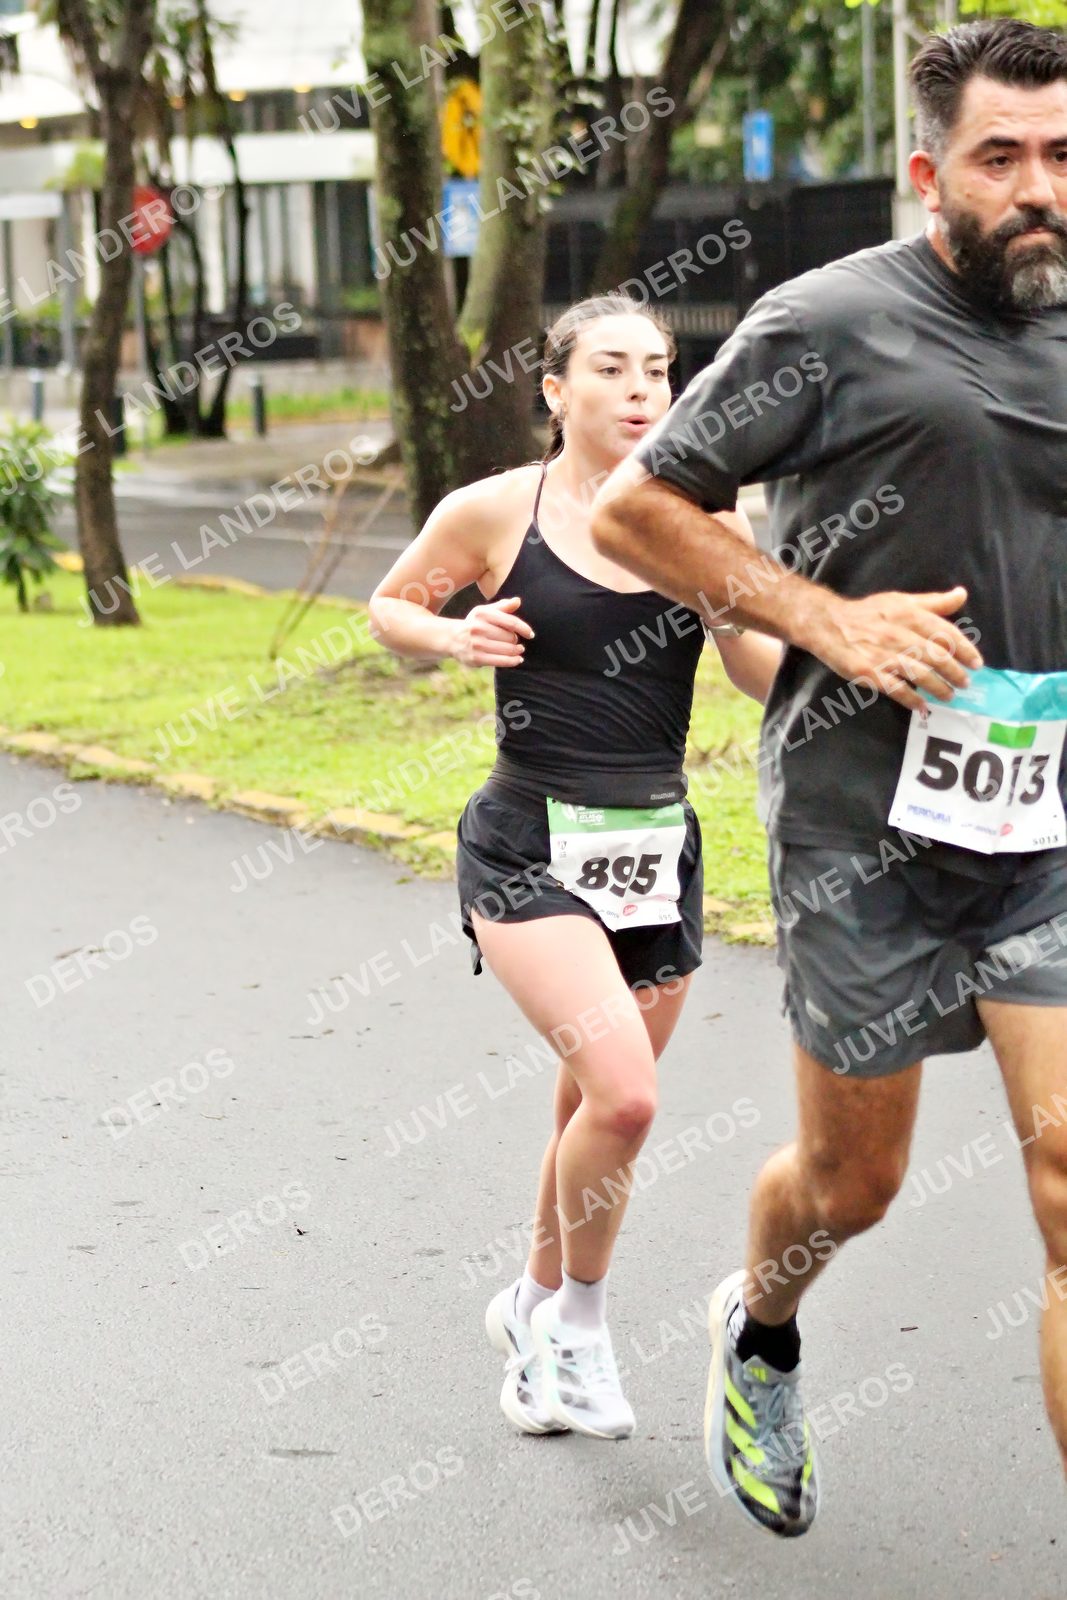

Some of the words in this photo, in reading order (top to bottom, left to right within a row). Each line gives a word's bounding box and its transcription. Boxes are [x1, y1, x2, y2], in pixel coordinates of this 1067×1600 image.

[916, 736, 1050, 808] 5013
[1032, 834, 1060, 846] 5013
[575, 853, 663, 898] 895
